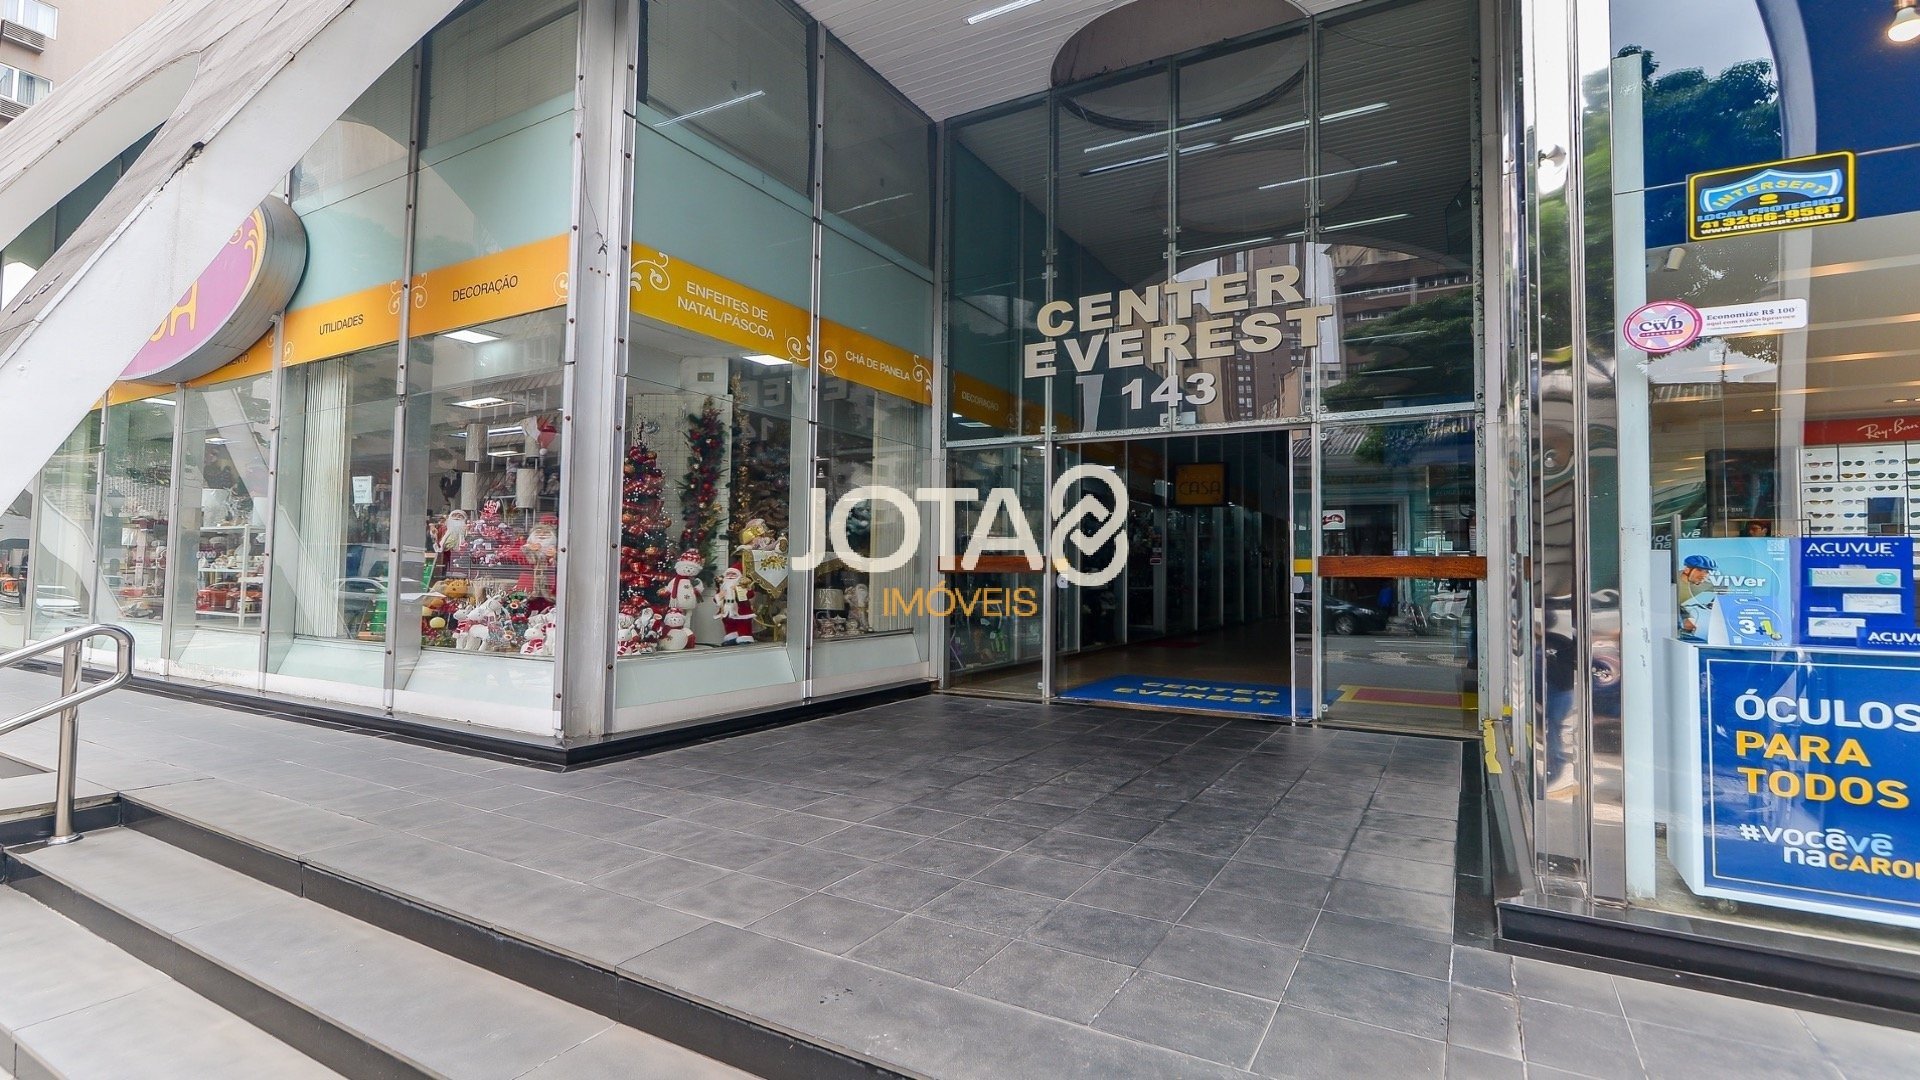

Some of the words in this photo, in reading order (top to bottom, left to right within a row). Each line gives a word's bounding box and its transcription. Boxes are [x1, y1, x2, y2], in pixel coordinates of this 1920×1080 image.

[1712, 180, 1828, 206] INTERSEPT
[1697, 210, 1746, 222] LOCAL
[1748, 196, 1844, 216] PROTEGIDO
[1701, 220, 1720, 230] 41
[1722, 203, 1841, 227] 3266-9581
[452, 274, 518, 302] DECORAÇÃO
[686, 280, 749, 315] ENFEITES
[751, 305, 769, 322] DE
[1036, 264, 1304, 337] CENTER
[319, 313, 364, 336] UTILIDADES
[677, 295, 775, 341] NATAL/PÁSCOA
[1706, 310, 1760, 321] Economize
[1762, 307, 1775, 316] R$
[1778, 306, 1796, 314] 100
[1024, 305, 1334, 379] EVEREST
[845, 350, 865, 367] CHÁ
[866, 359, 880, 371] DE
[880, 364, 911, 382] PANELA
[1121, 372, 1217, 410] 143
[1857, 418, 1920, 439] Ray-Ban
[1806, 542, 1893, 554] ACUVUE
[1710, 575, 1766, 587] ViVer
[1113, 687, 1281, 705] EVEREST
[1142, 682, 1279, 697] CENTER
[1735, 688, 1920, 733] ÓCULOS
[1736, 730, 1872, 768] PARA
[1737, 767, 1910, 809] TODOS
[1783, 847, 1920, 880] naCARO
